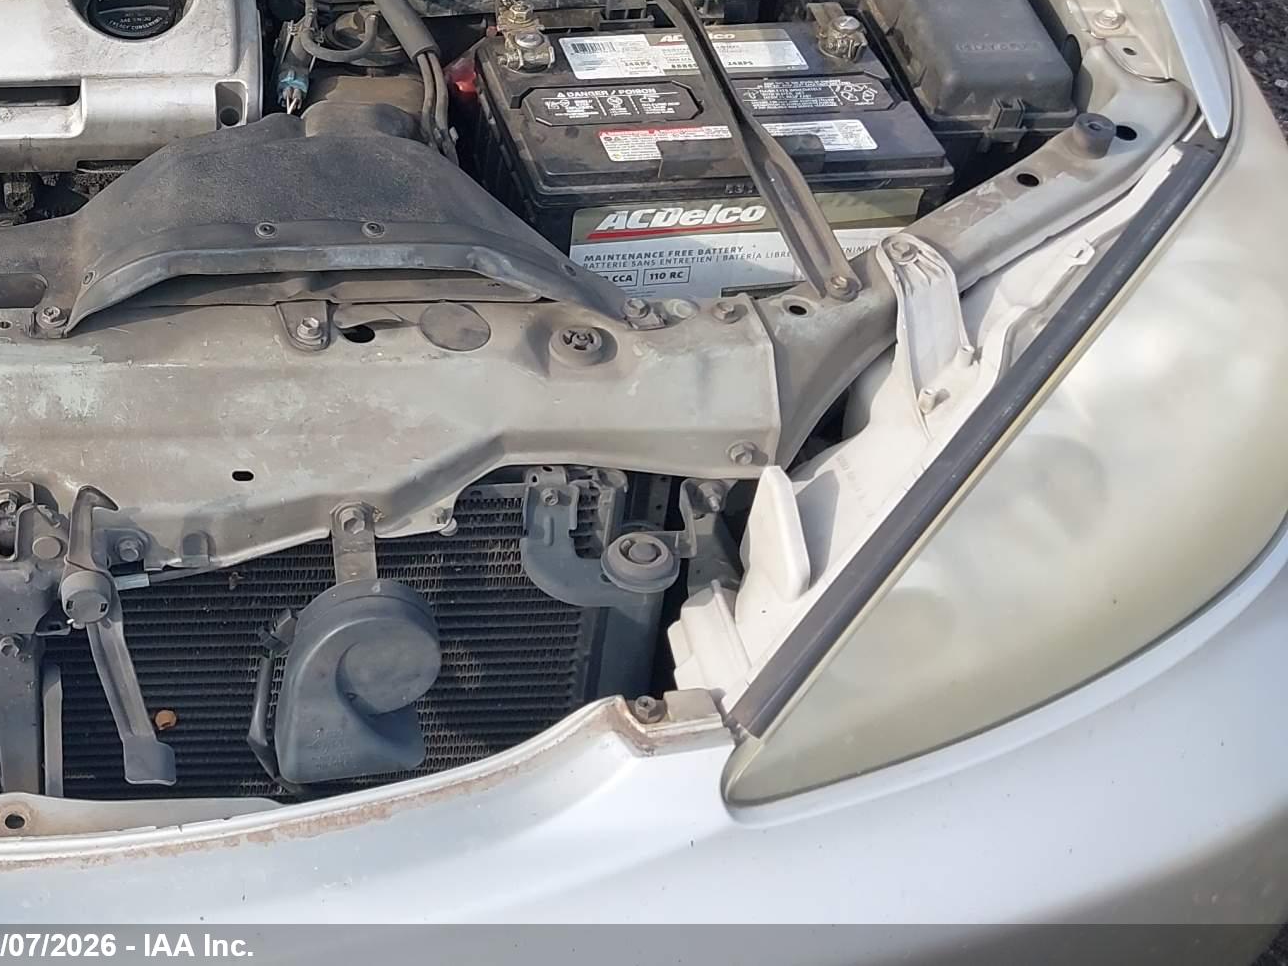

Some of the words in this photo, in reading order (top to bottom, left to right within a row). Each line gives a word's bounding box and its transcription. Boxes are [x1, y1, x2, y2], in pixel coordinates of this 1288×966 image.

[566, 90, 609, 98] DANGER
[594, 203, 767, 231] ACDelco
[584, 251, 665, 263] MAINTENANCE
[668, 249, 694, 258] FREE
[697, 246, 744, 257] BATTERY
[631, 258, 656, 267] SANS
[660, 256, 713, 266] ENTRETIEN
[612, 274, 633, 283] CCA
[649, 272, 666, 281] 110
[669, 271, 684, 280] RC
